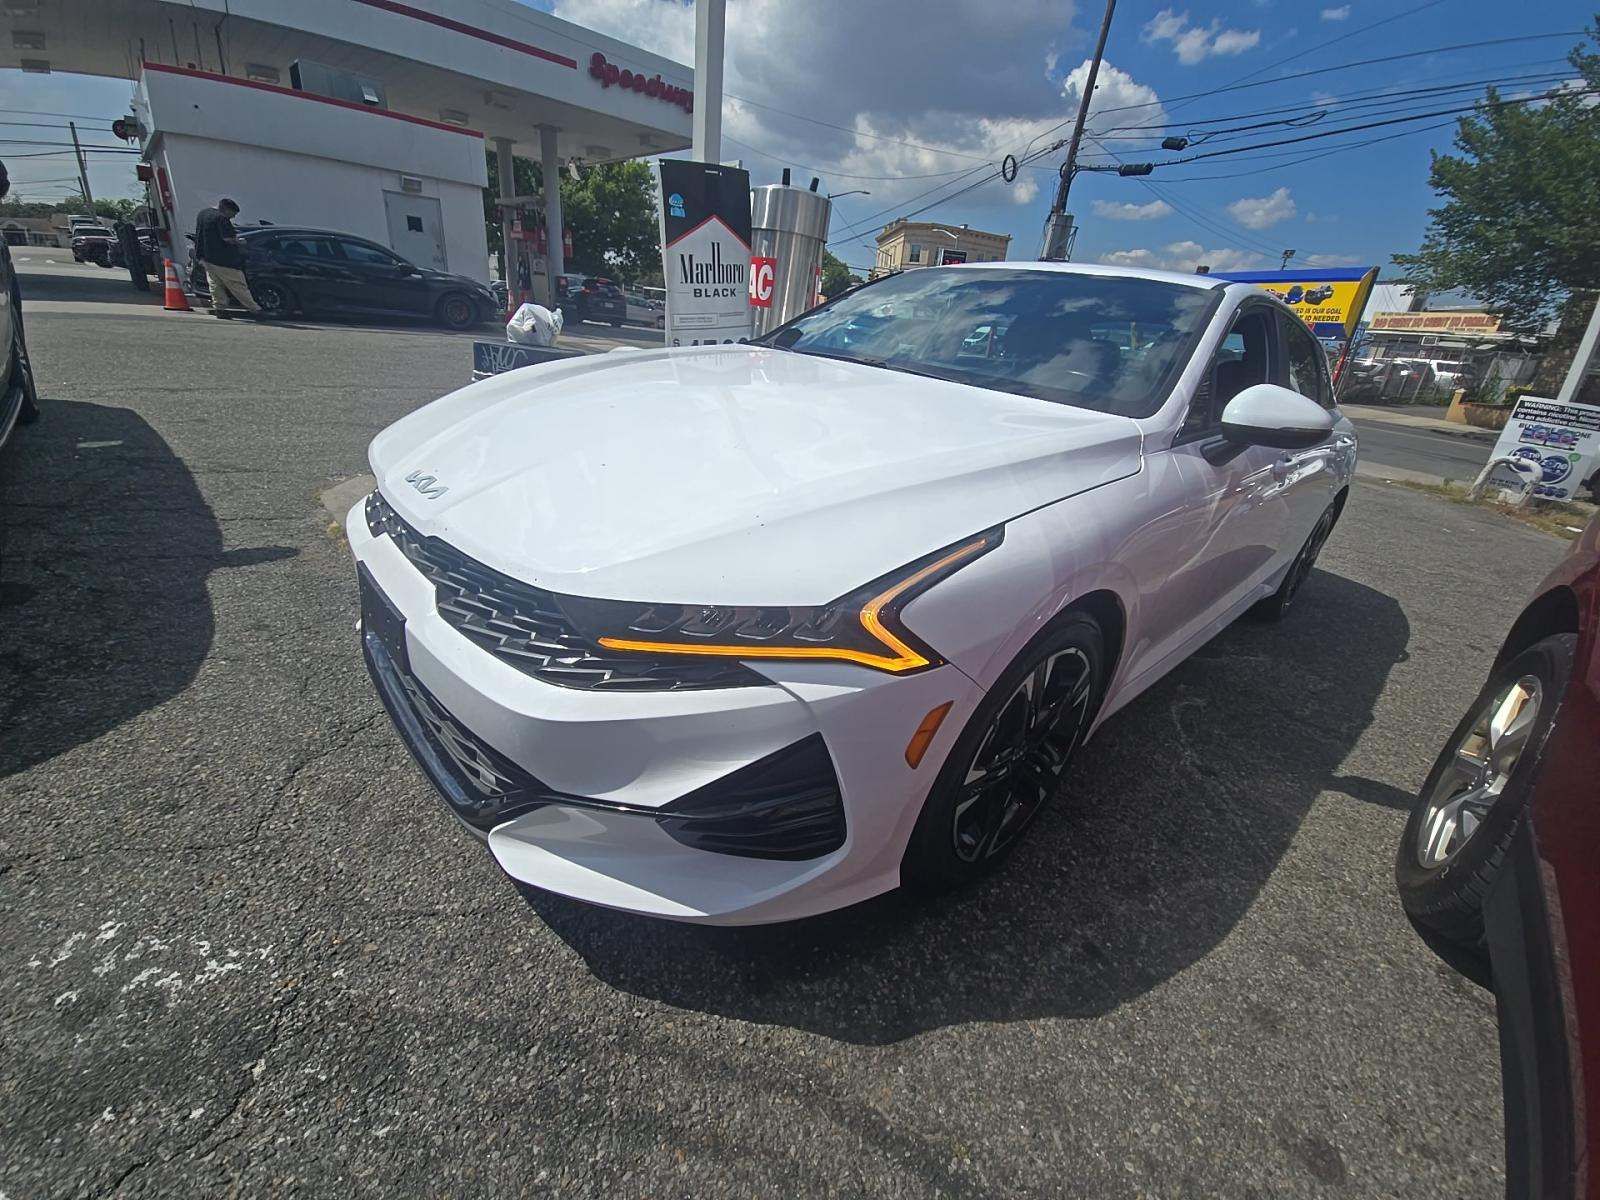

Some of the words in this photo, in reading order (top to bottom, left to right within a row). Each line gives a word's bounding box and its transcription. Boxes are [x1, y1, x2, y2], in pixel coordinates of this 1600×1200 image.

[680, 241, 744, 284] Marlboro
[693, 288, 737, 298] BLACK
[1325, 307, 1342, 315] GOAL
